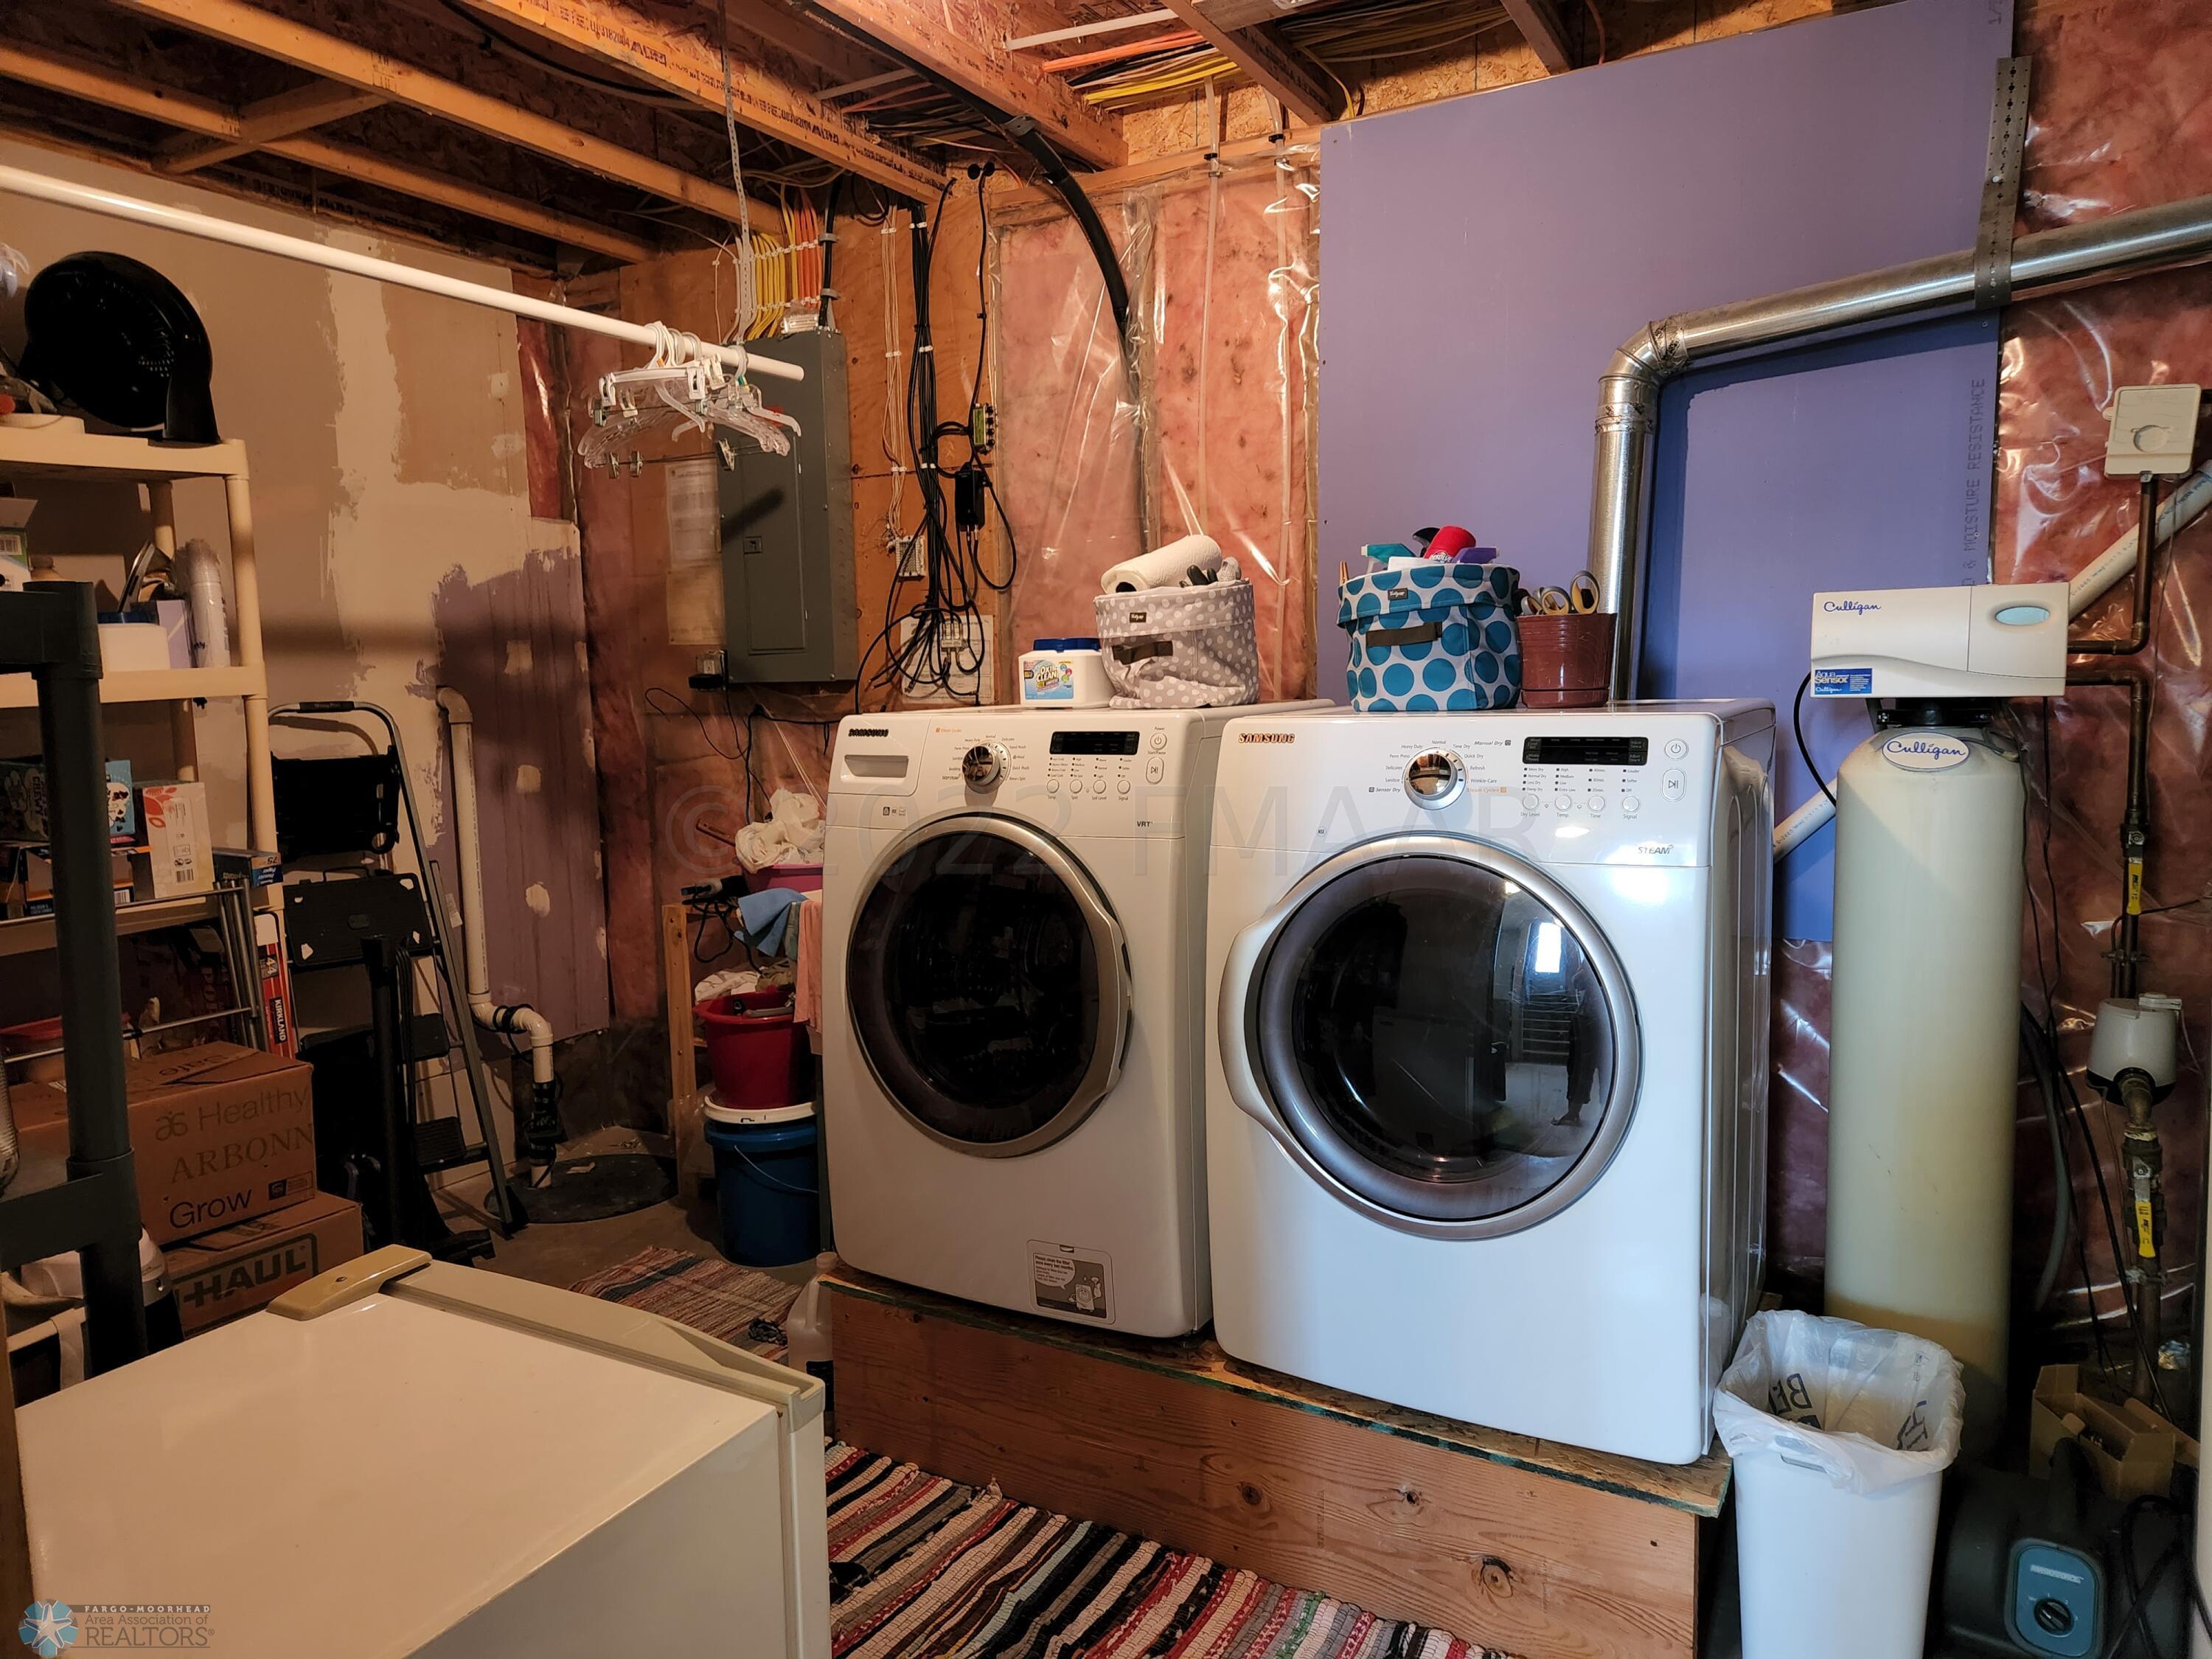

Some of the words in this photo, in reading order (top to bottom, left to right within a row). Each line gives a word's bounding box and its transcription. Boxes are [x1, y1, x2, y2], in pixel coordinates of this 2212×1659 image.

[1966, 378, 1985, 470] RESISTANCE
[1964, 479, 1980, 552] MOISTURE
[1823, 601, 1882, 616] Culligan
[1036, 669, 1057, 682] CLEAN
[1040, 665, 1053, 674] OXI
[1815, 675, 1849, 684] Sensor
[848, 728, 889, 737] SAMSUNG
[1238, 733, 1295, 744] SAMSUNG
[1885, 740, 1966, 760] Culligan
[1638, 846, 1671, 855] STEAM
[266, 957, 278, 975] 44
[274, 999, 287, 1041] KIRKLAND
[198, 1086, 308, 1132] Healthy
[169, 1189, 254, 1229] Grow
[175, 1249, 306, 1308] -HAUL
